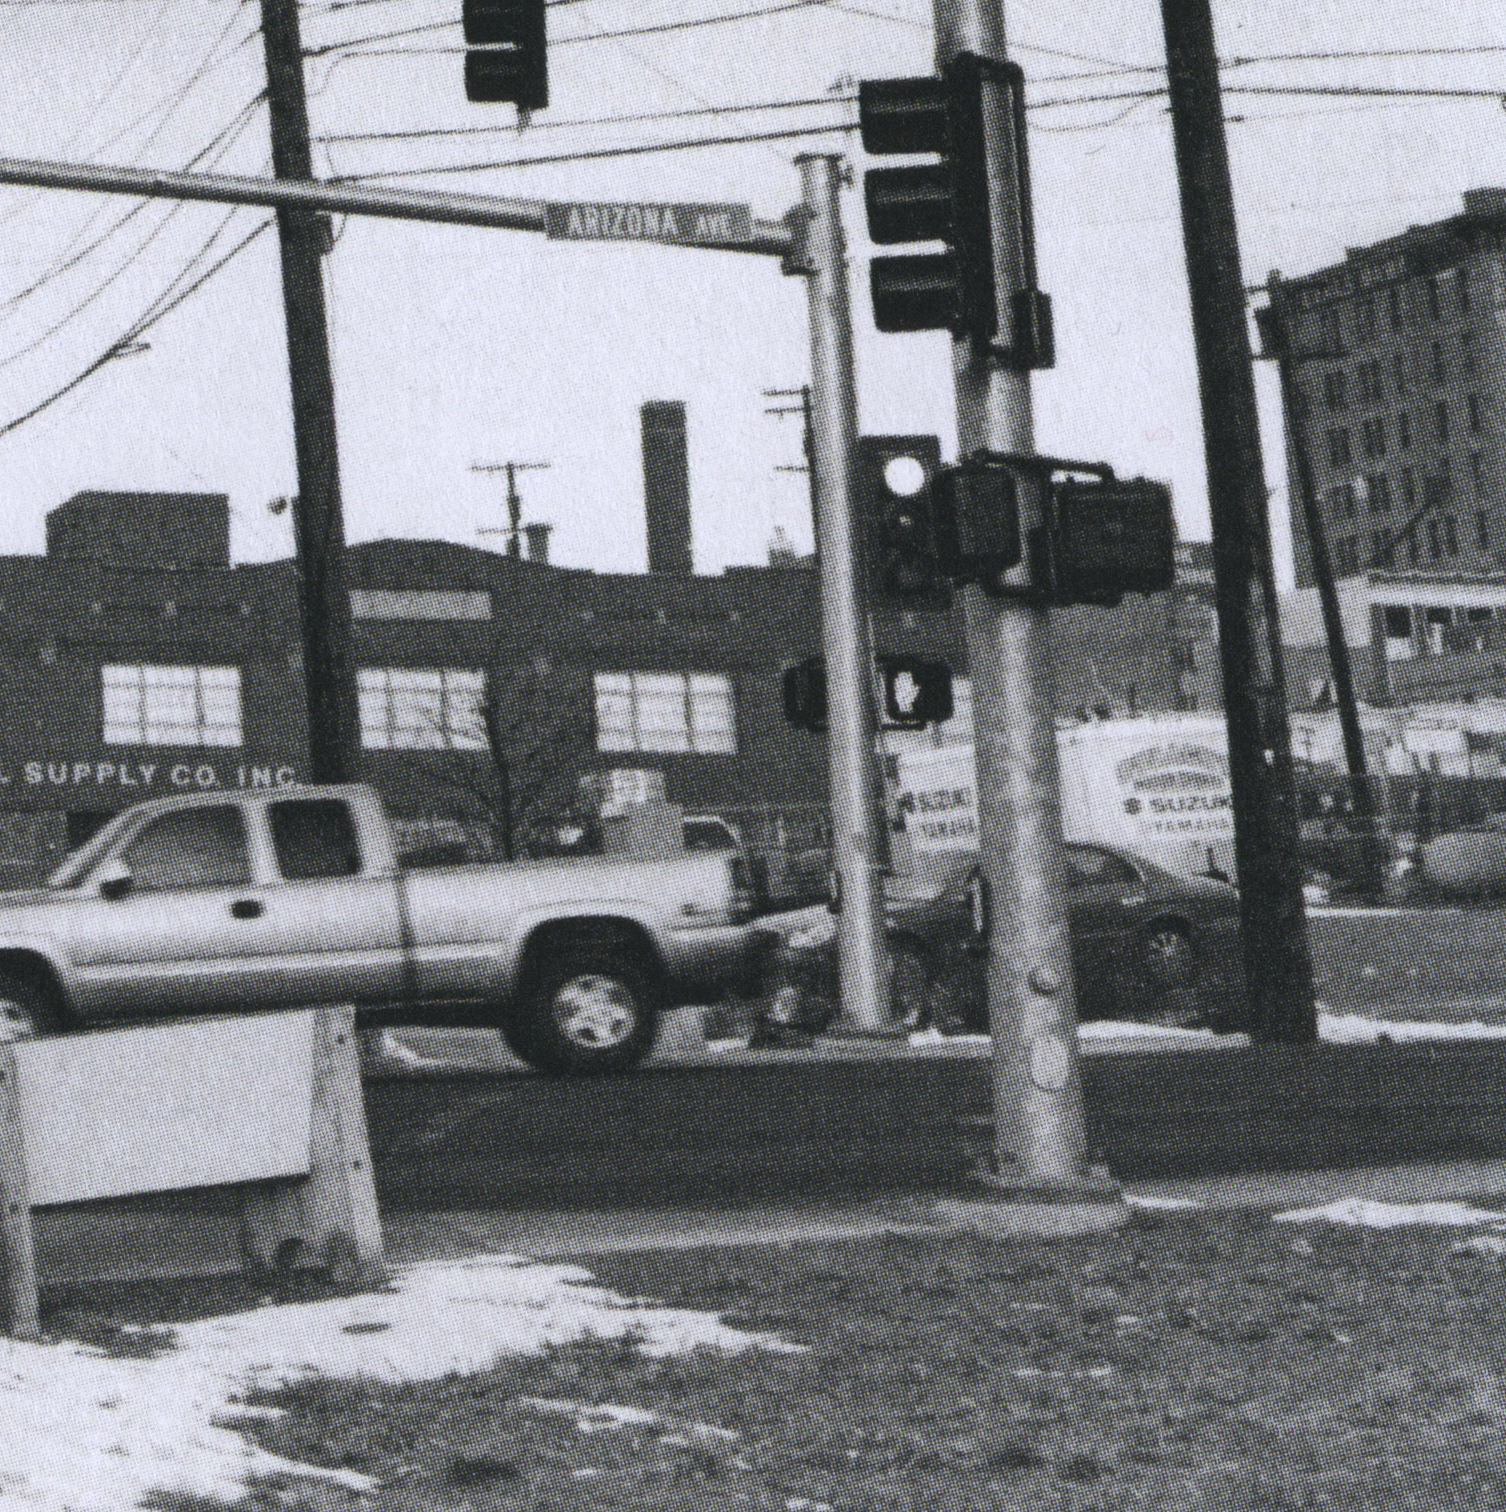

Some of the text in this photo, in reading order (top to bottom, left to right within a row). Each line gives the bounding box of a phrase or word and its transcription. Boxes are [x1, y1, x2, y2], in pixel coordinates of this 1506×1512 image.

[568, 206, 679, 237] ARIZONA
[24, 761, 157, 785] SUPPLY
[1149, 795, 1233, 813] SUZUK
